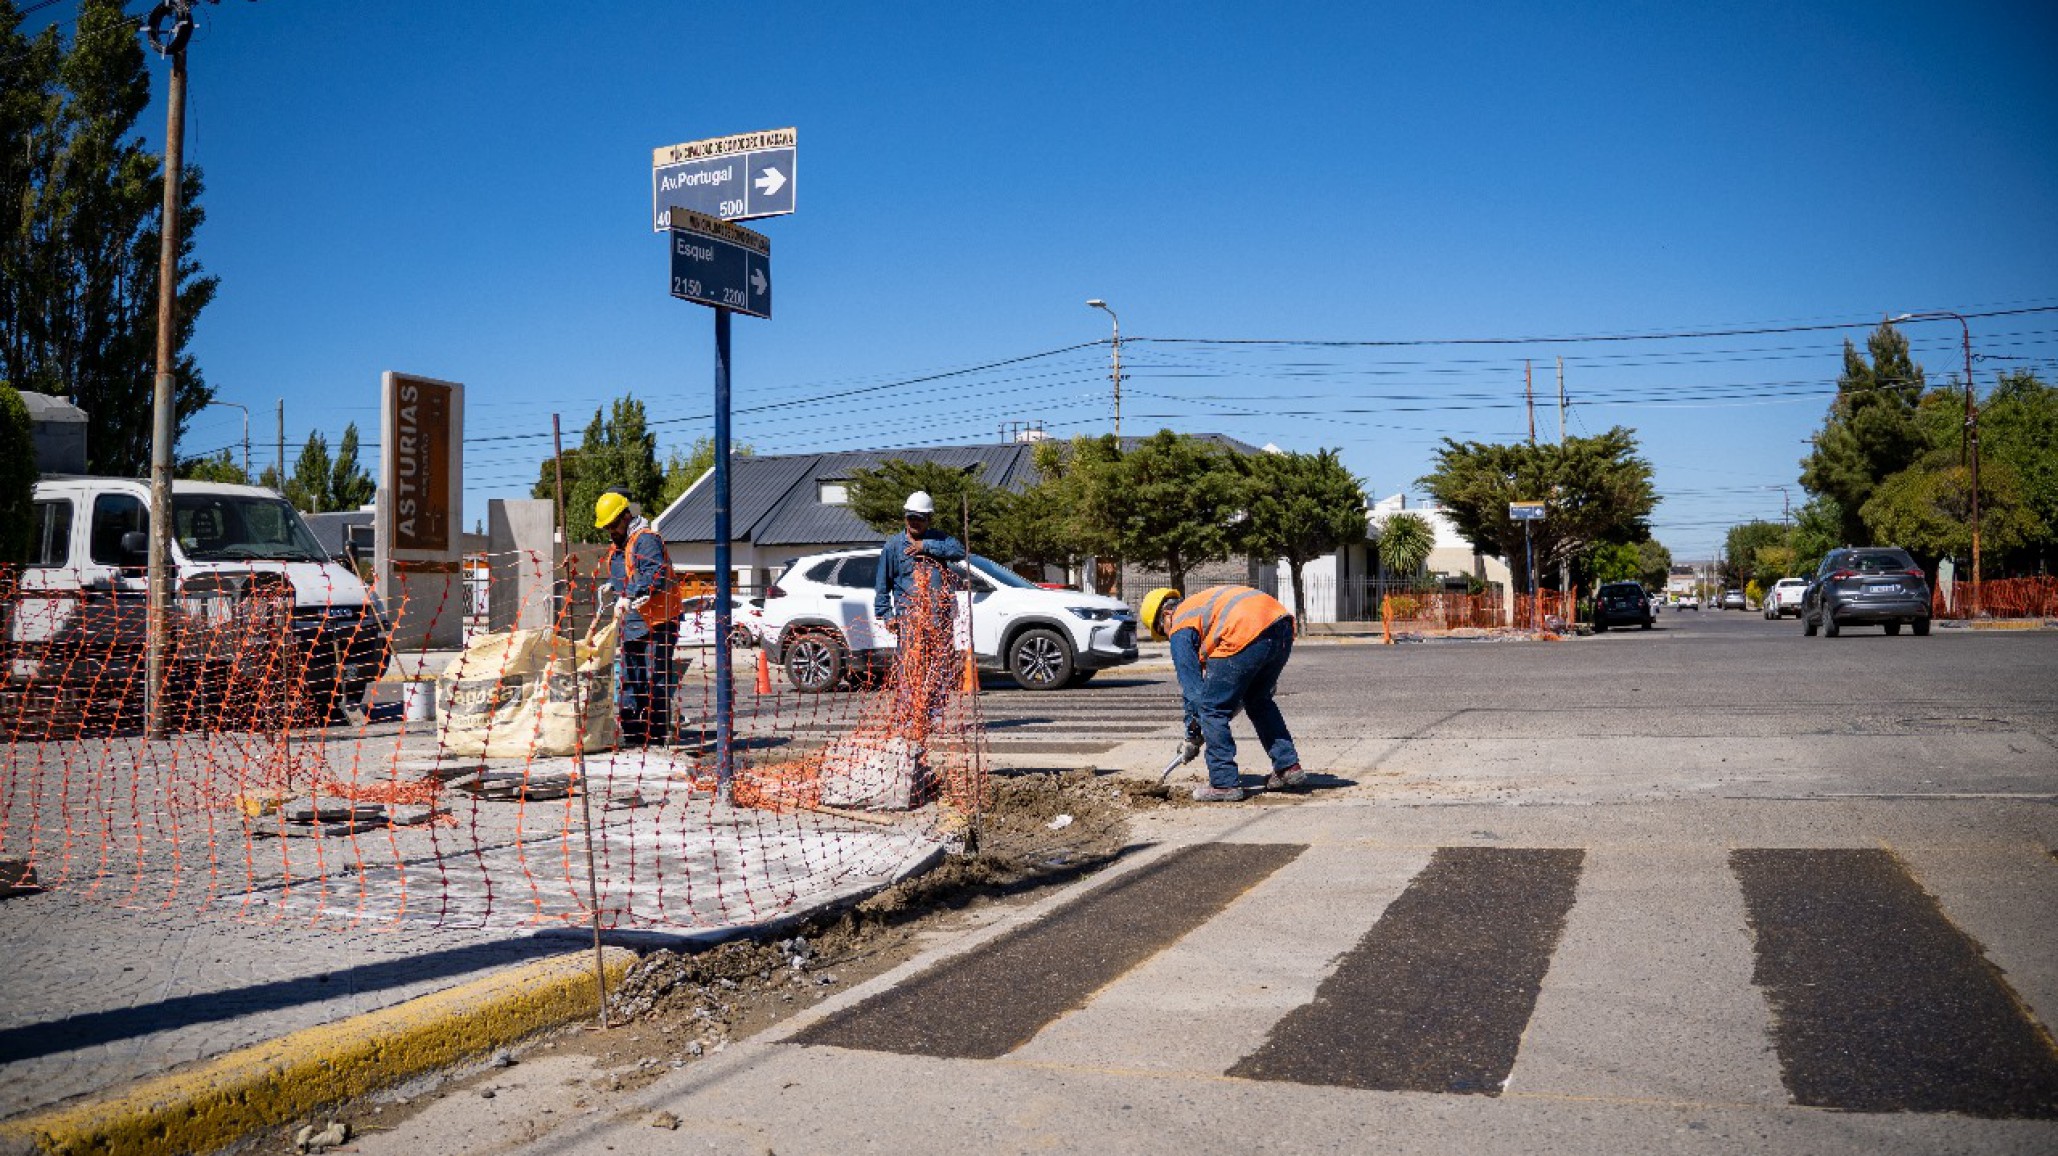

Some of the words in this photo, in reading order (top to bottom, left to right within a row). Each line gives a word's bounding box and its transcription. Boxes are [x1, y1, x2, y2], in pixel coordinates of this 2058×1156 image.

[719, 199, 744, 217] 500
[676, 238, 714, 262] Esquel
[674, 276, 702, 297] 2150
[722, 287, 745, 307] 2200
[399, 385, 419, 538] ASTURIAS
